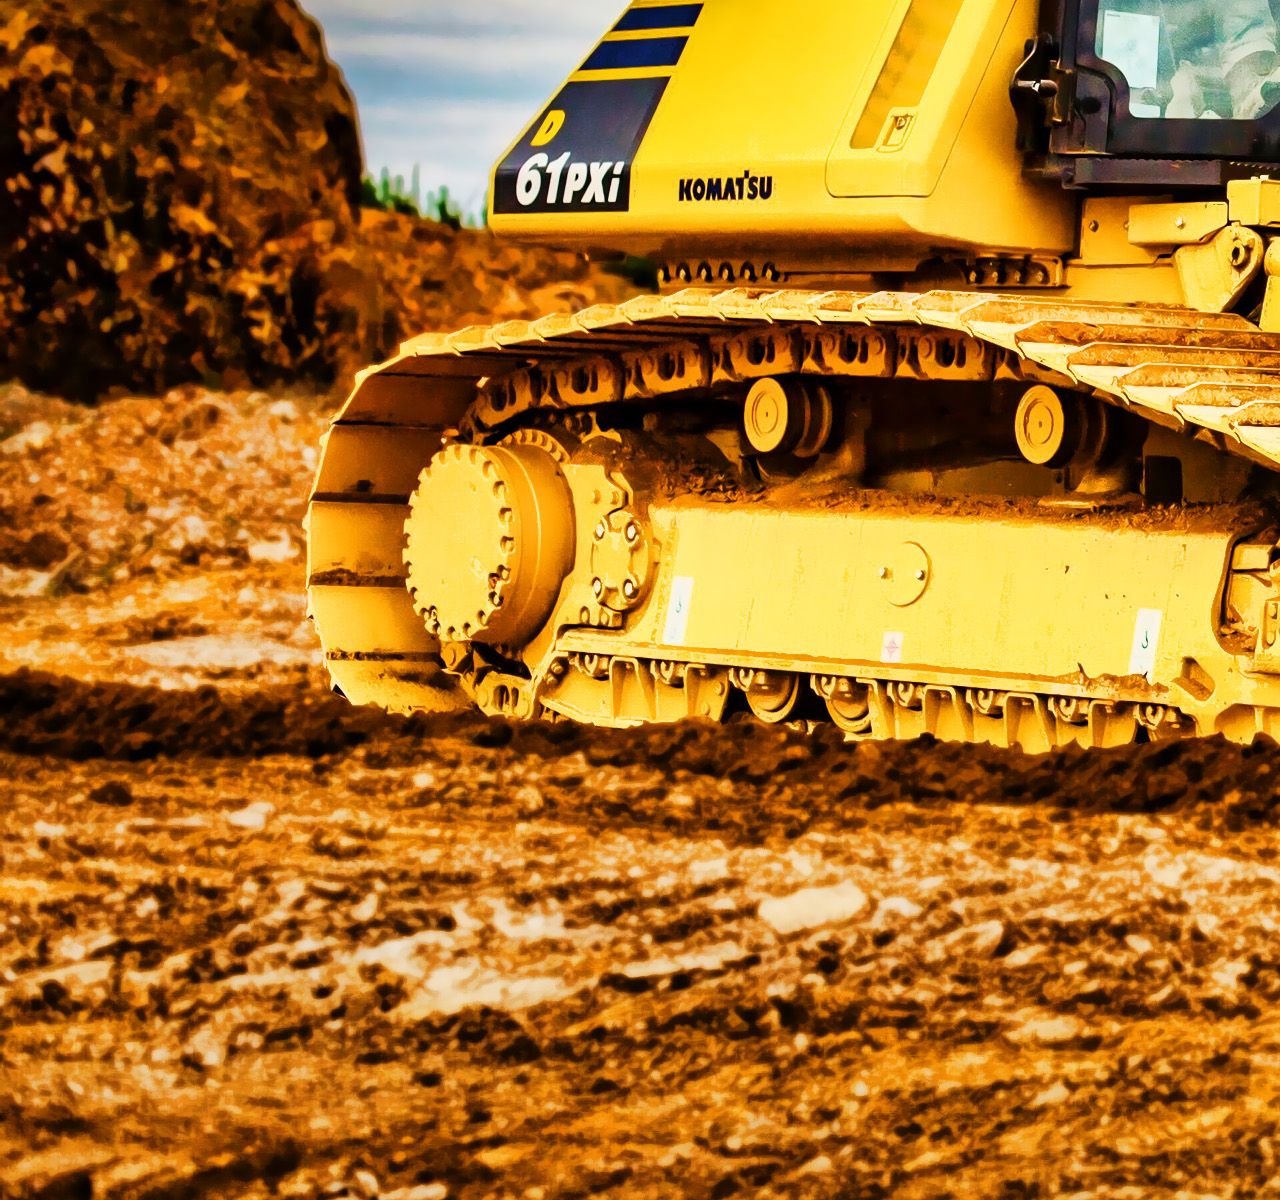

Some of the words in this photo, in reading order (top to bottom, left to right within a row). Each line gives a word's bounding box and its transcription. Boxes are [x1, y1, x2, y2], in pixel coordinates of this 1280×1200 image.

[530, 109, 566, 147] D
[515, 152, 625, 206] 61PXi
[678, 169, 773, 202] KOMATSU
